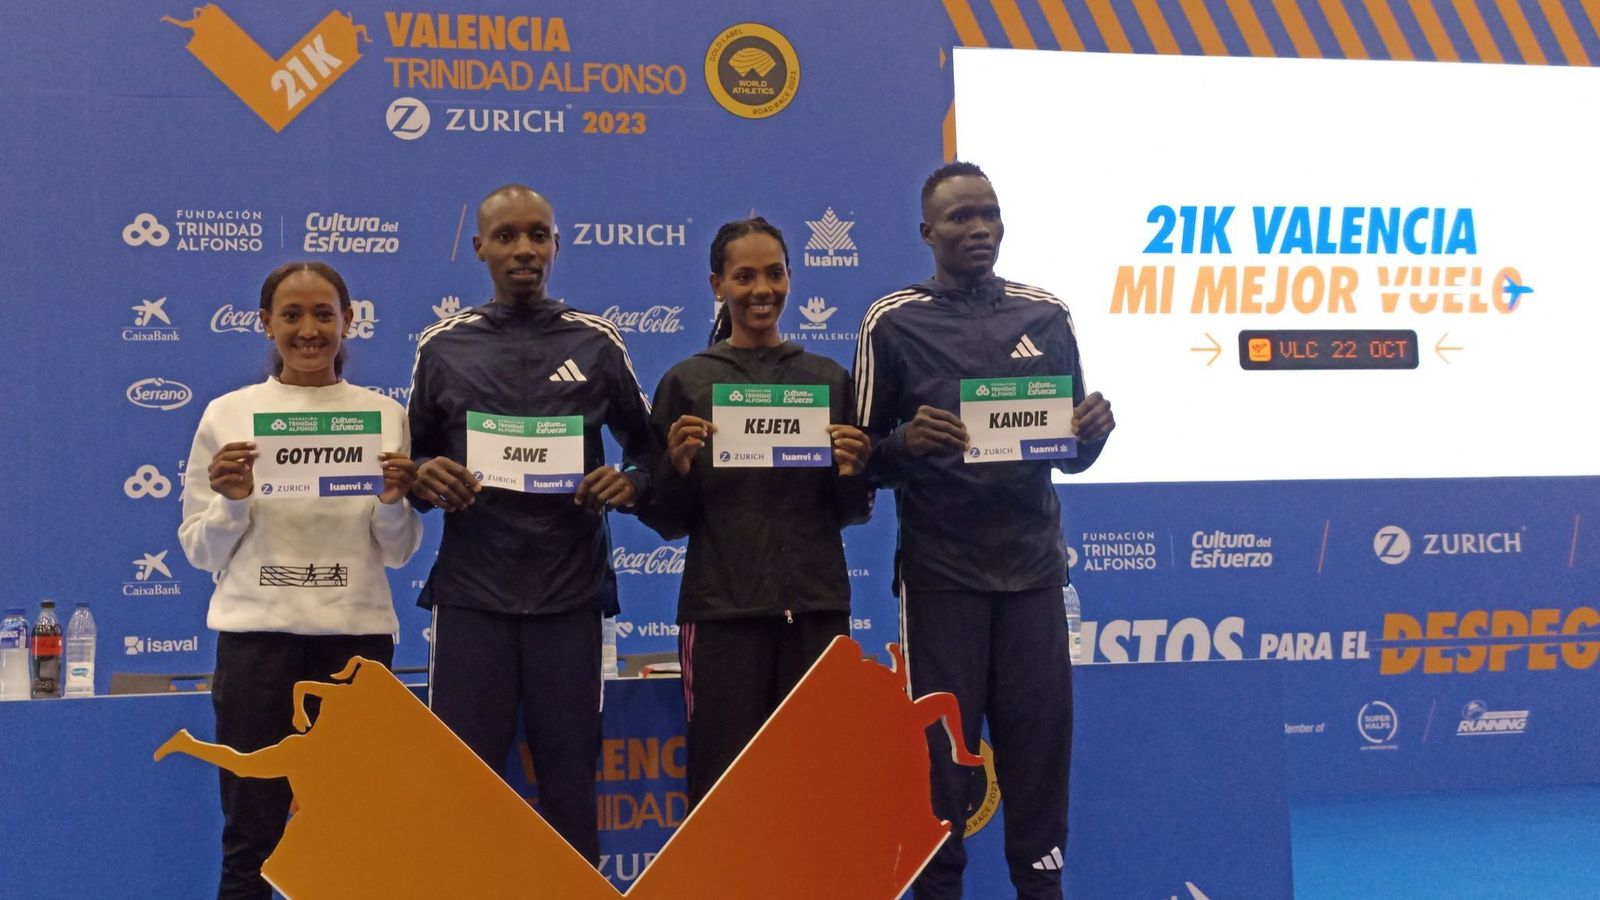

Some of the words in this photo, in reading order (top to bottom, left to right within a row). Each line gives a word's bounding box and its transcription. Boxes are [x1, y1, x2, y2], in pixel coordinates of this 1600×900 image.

[384, 12, 570, 53] VALENCIA
[270, 33, 343, 111] 21K
[384, 57, 534, 90] TRINIDAD
[538, 62, 687, 96] ALFONSO
[738, 80, 767, 88] WORLD
[446, 107, 565, 133] ZURICH
[582, 112, 648, 135] 2023
[176, 209, 262, 220] FUNDACIÓN
[176, 222, 263, 237] TRINIDAD
[305, 212, 379, 233] Cultura
[381, 221, 399, 232] del
[1142, 204, 1236, 254] 21K
[1251, 206, 1477, 255] VALENCIA
[573, 223, 687, 247] ZURICH
[176, 237, 263, 252] ALFONSO
[303, 232, 400, 254] Esfuerzo
[803, 253, 859, 267] luanvi
[1109, 265, 1175, 314] MI
[1190, 265, 1359, 314] MEJOR
[1377, 265, 1523, 314] VUELO
[121, 330, 180, 341] CaixaBank
[1279, 340, 1319, 359] VLC
[1331, 340, 1357, 359] 22
[1369, 340, 1407, 359] OCT
[133, 387, 186, 401] Serrano
[744, 418, 800, 434] KEJETA
[989, 411, 1048, 429] KANDIE
[276, 446, 363, 465] GOTYTOM
[503, 446, 548, 463] SAWE
[781, 453, 811, 461] luanvi
[1030, 445, 1058, 454] luanvi
[329, 482, 361, 491] luanvi
[487, 474, 516, 484] ZURICH
[533, 480, 563, 488] luanvi
[277, 484, 310, 492] ZURICH
[1083, 531, 1155, 541] FUNDACIÓN
[1192, 530, 1255, 549] Cultura
[1256, 537, 1271, 548] del
[1083, 542, 1156, 557] TRINIDAD
[1423, 533, 1521, 555] ZURICH
[1083, 556, 1157, 571] ALFONSO
[1190, 550, 1273, 568] Esfuerzo
[122, 584, 181, 596] CaixaBank
[637, 622, 680, 636] vitha
[147, 636, 198, 653] isaval
[1079, 616, 1245, 663] ISTOS
[1259, 631, 1333, 661] PARA
[1341, 631, 1370, 659] EL
[1379, 607, 1600, 676] DESPEG
[1315, 722, 1325, 733] of
[1457, 719, 1527, 733] RUNNING
